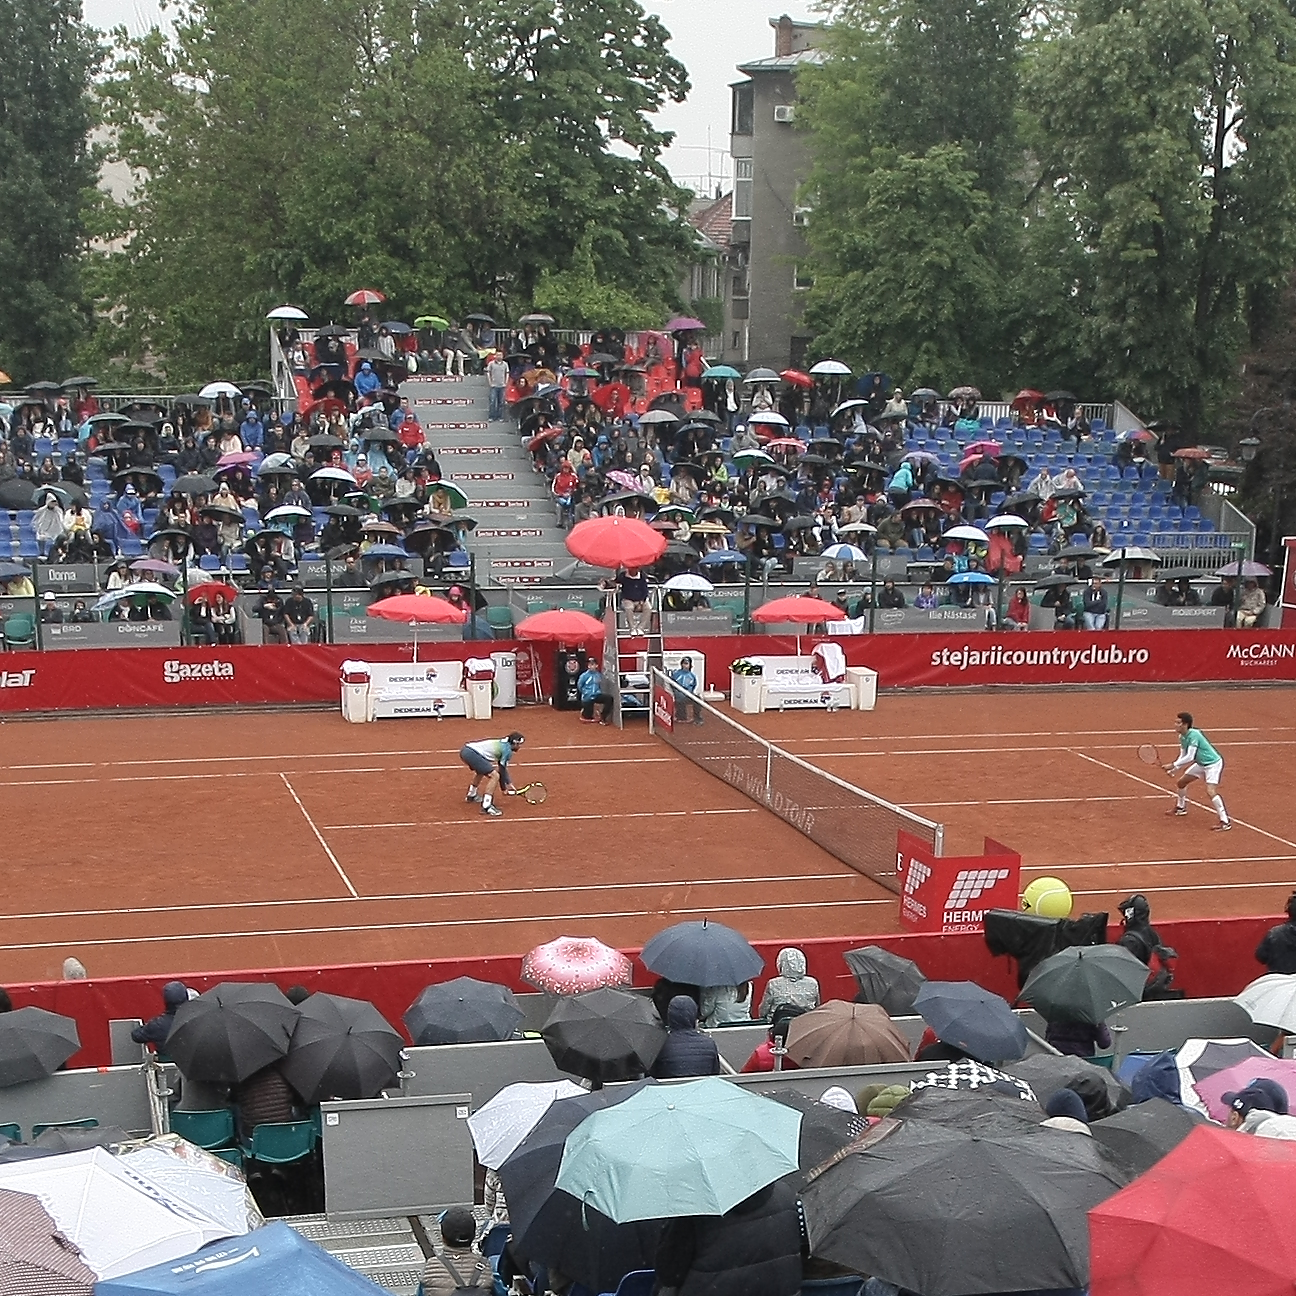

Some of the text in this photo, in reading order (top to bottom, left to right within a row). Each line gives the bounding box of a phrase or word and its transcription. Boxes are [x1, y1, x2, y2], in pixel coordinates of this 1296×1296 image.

[48, 568, 76, 582] Dorna
[929, 610, 943, 620] Ilie
[62, 625, 82, 633] BRD
[930, 643, 1150, 670] stejariicountryclub.ro
[1226, 643, 1296, 659] McCANN
[164, 659, 235, 683] gazeta
[784, 698, 819, 706] DEDEMAN
[724, 762, 745, 783] ATP
[783, 800, 815, 834] TOUR
[943, 910, 990, 923] HERM
